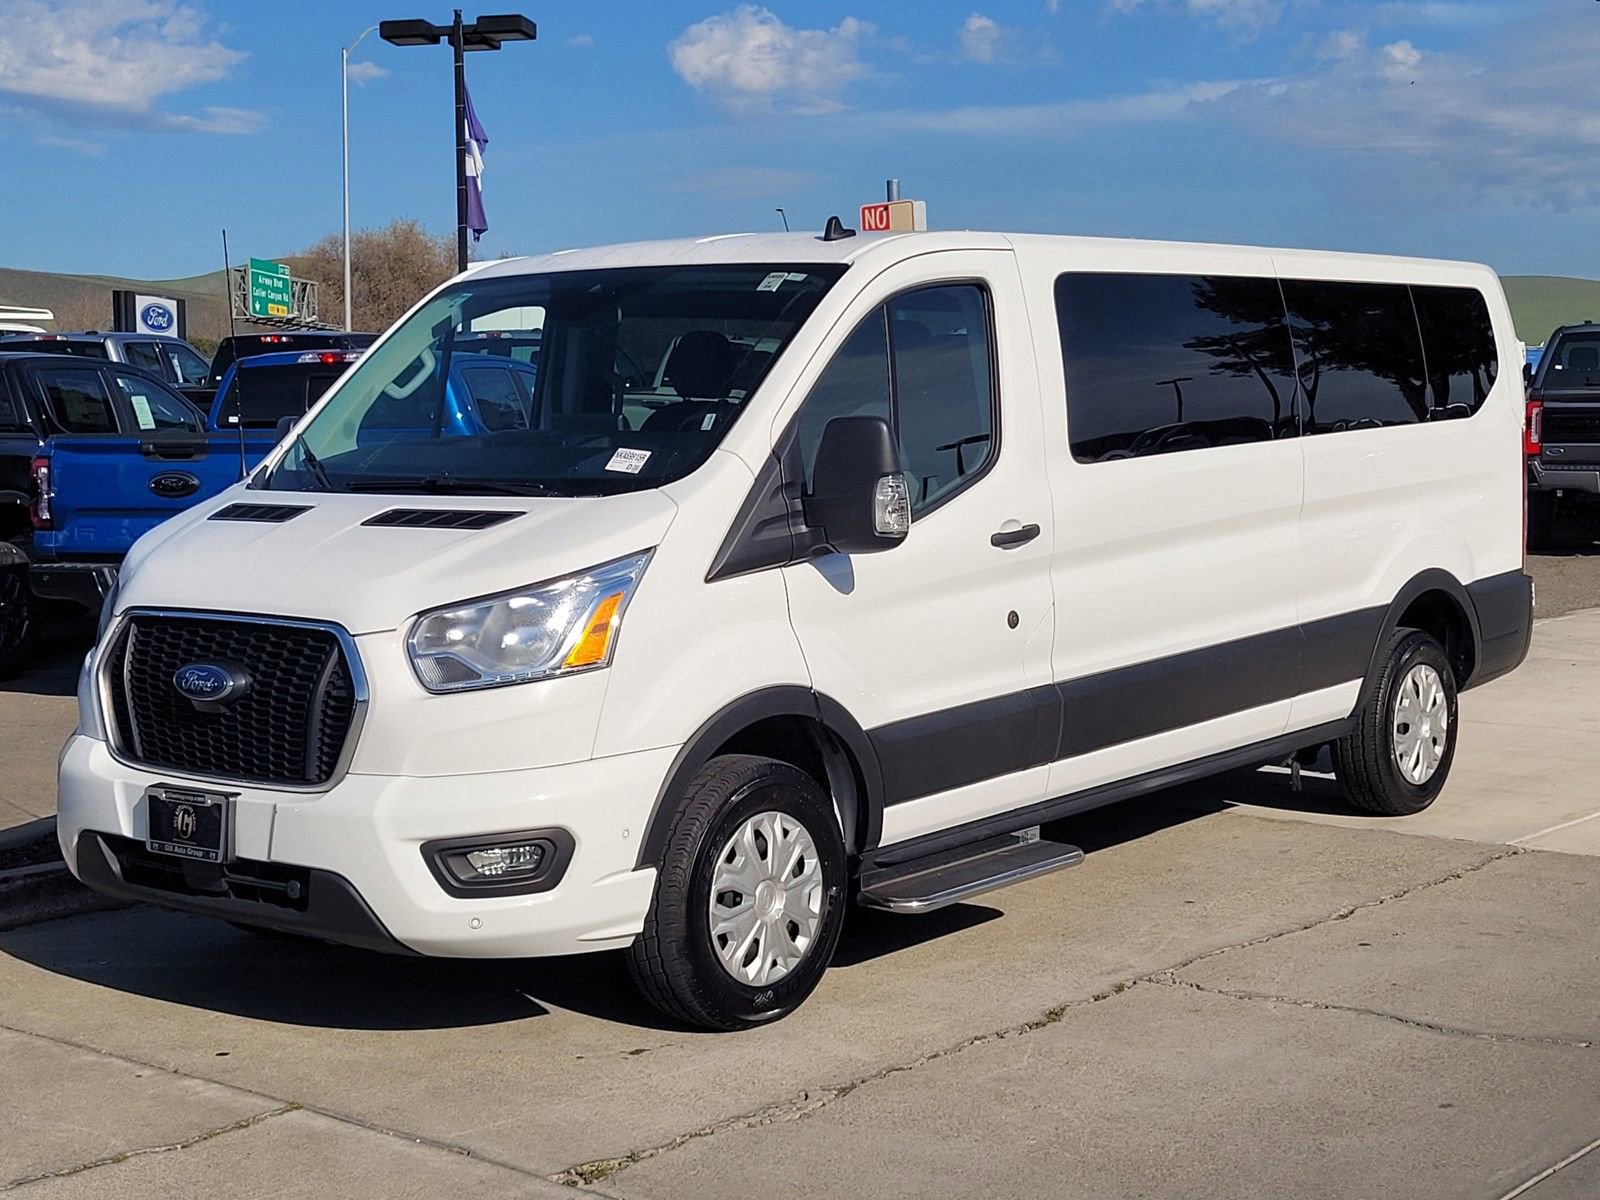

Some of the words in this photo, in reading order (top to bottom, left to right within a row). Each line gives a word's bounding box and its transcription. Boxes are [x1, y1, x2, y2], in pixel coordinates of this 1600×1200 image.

[864, 207, 887, 230] NO
[258, 275, 273, 288] Airway
[273, 278, 283, 289] Blvd
[253, 286, 267, 298] Collier
[267, 290, 282, 302] Canyon
[147, 306, 169, 327] Ford
[182, 669, 215, 692] Ford
[173, 845, 186, 855] Auto
[186, 847, 204, 858] Group
